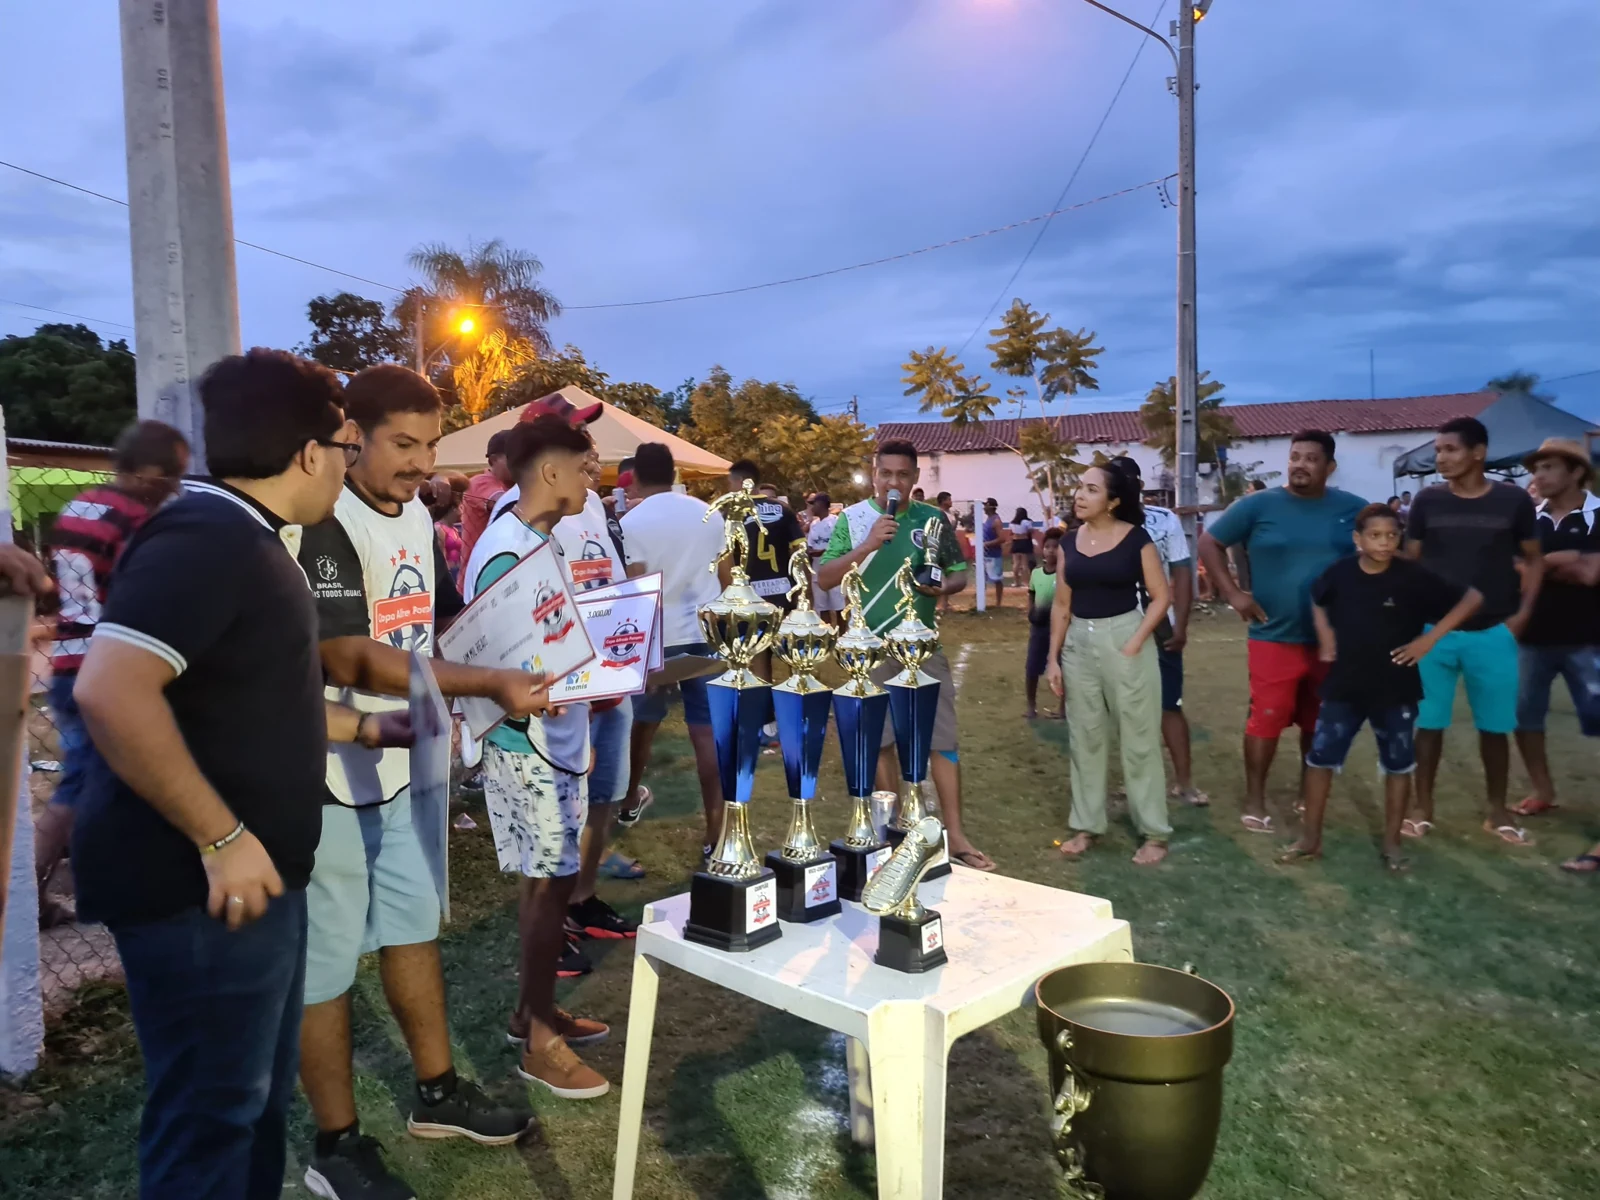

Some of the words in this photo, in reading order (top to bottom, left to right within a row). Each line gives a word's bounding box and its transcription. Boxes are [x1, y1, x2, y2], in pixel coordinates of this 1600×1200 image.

[757, 530, 779, 573] 4
[316, 582, 344, 590] BRASIL
[321, 590, 343, 598] TODOS
[343, 589, 362, 597] IGUAIS
[565, 684, 588, 692] themis
